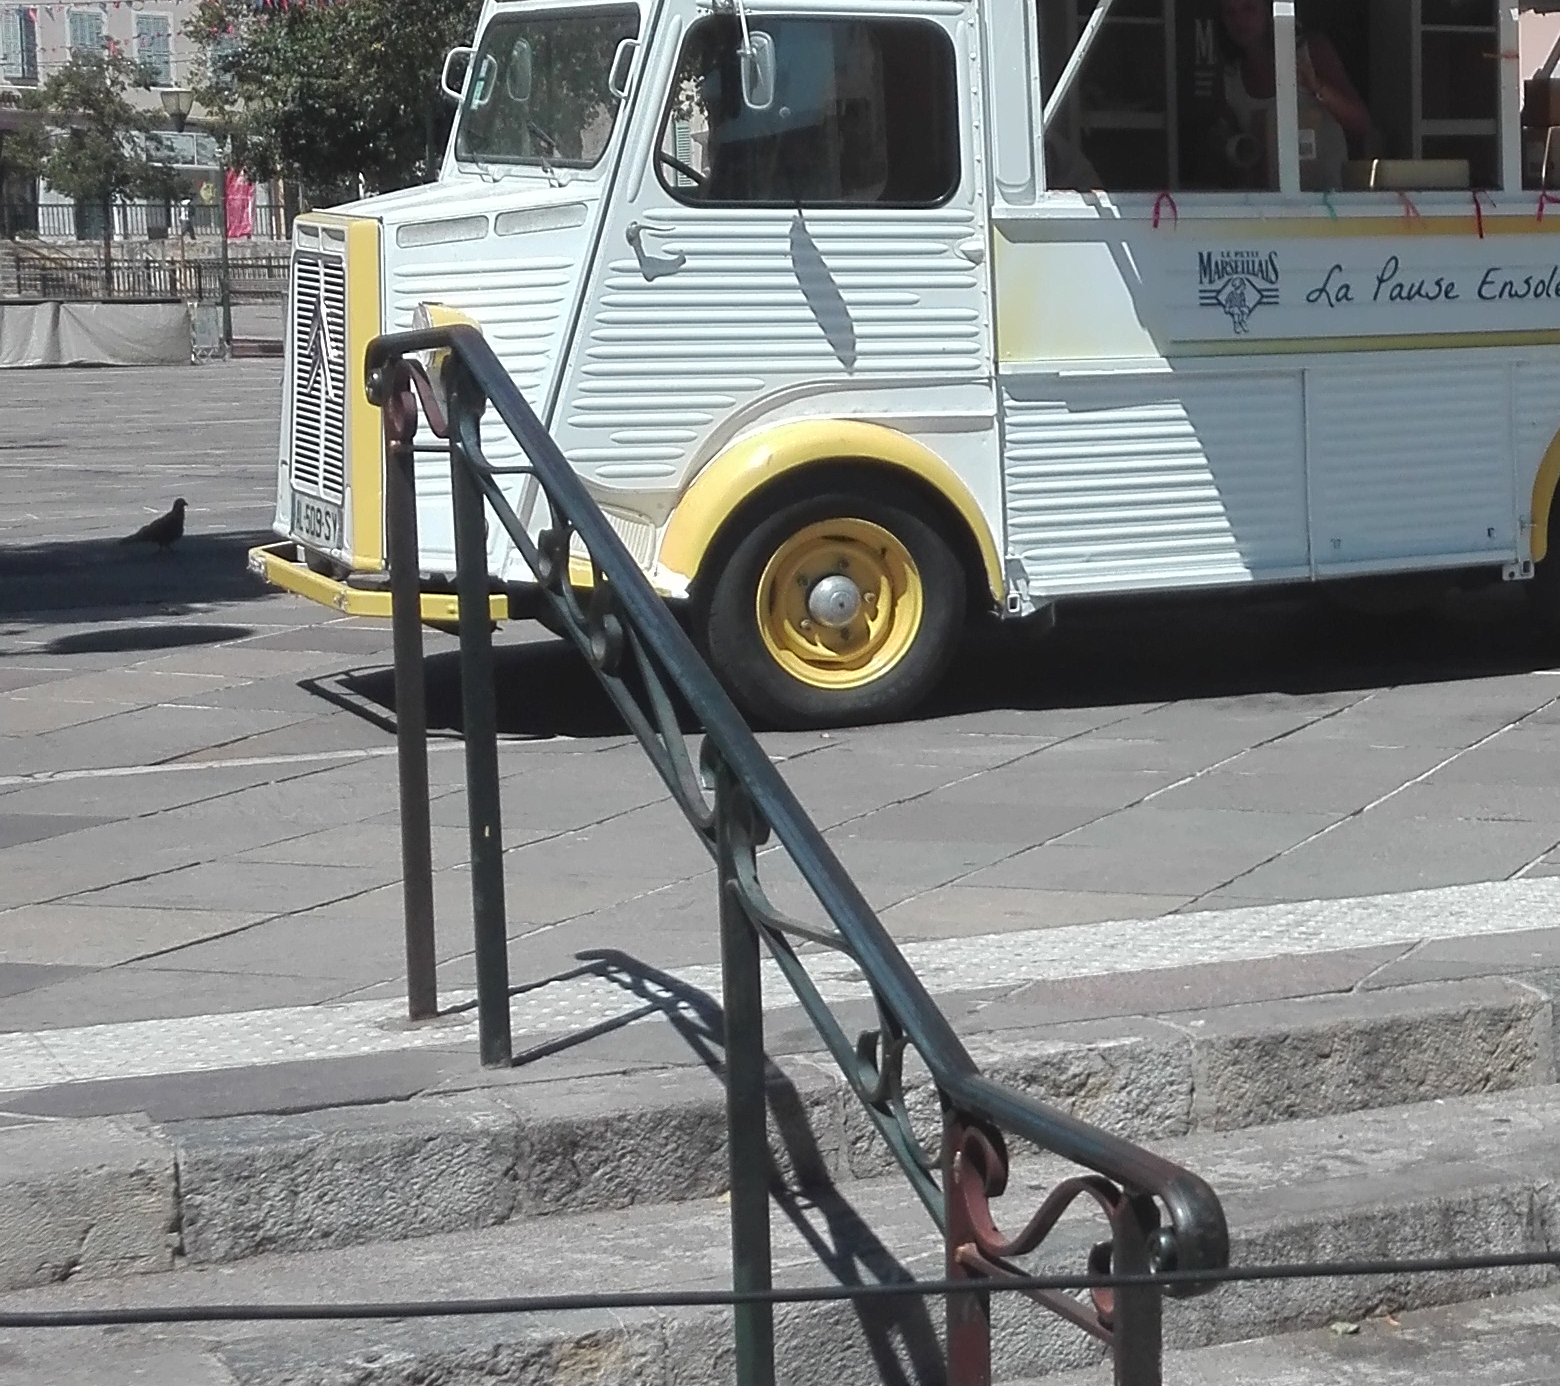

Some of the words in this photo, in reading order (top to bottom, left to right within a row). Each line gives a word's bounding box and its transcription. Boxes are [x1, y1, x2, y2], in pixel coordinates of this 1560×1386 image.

[1198, 250, 1279, 285] MARSEILLAIS
[1306, 264, 1354, 308] La
[1373, 255, 1460, 301] Pause
